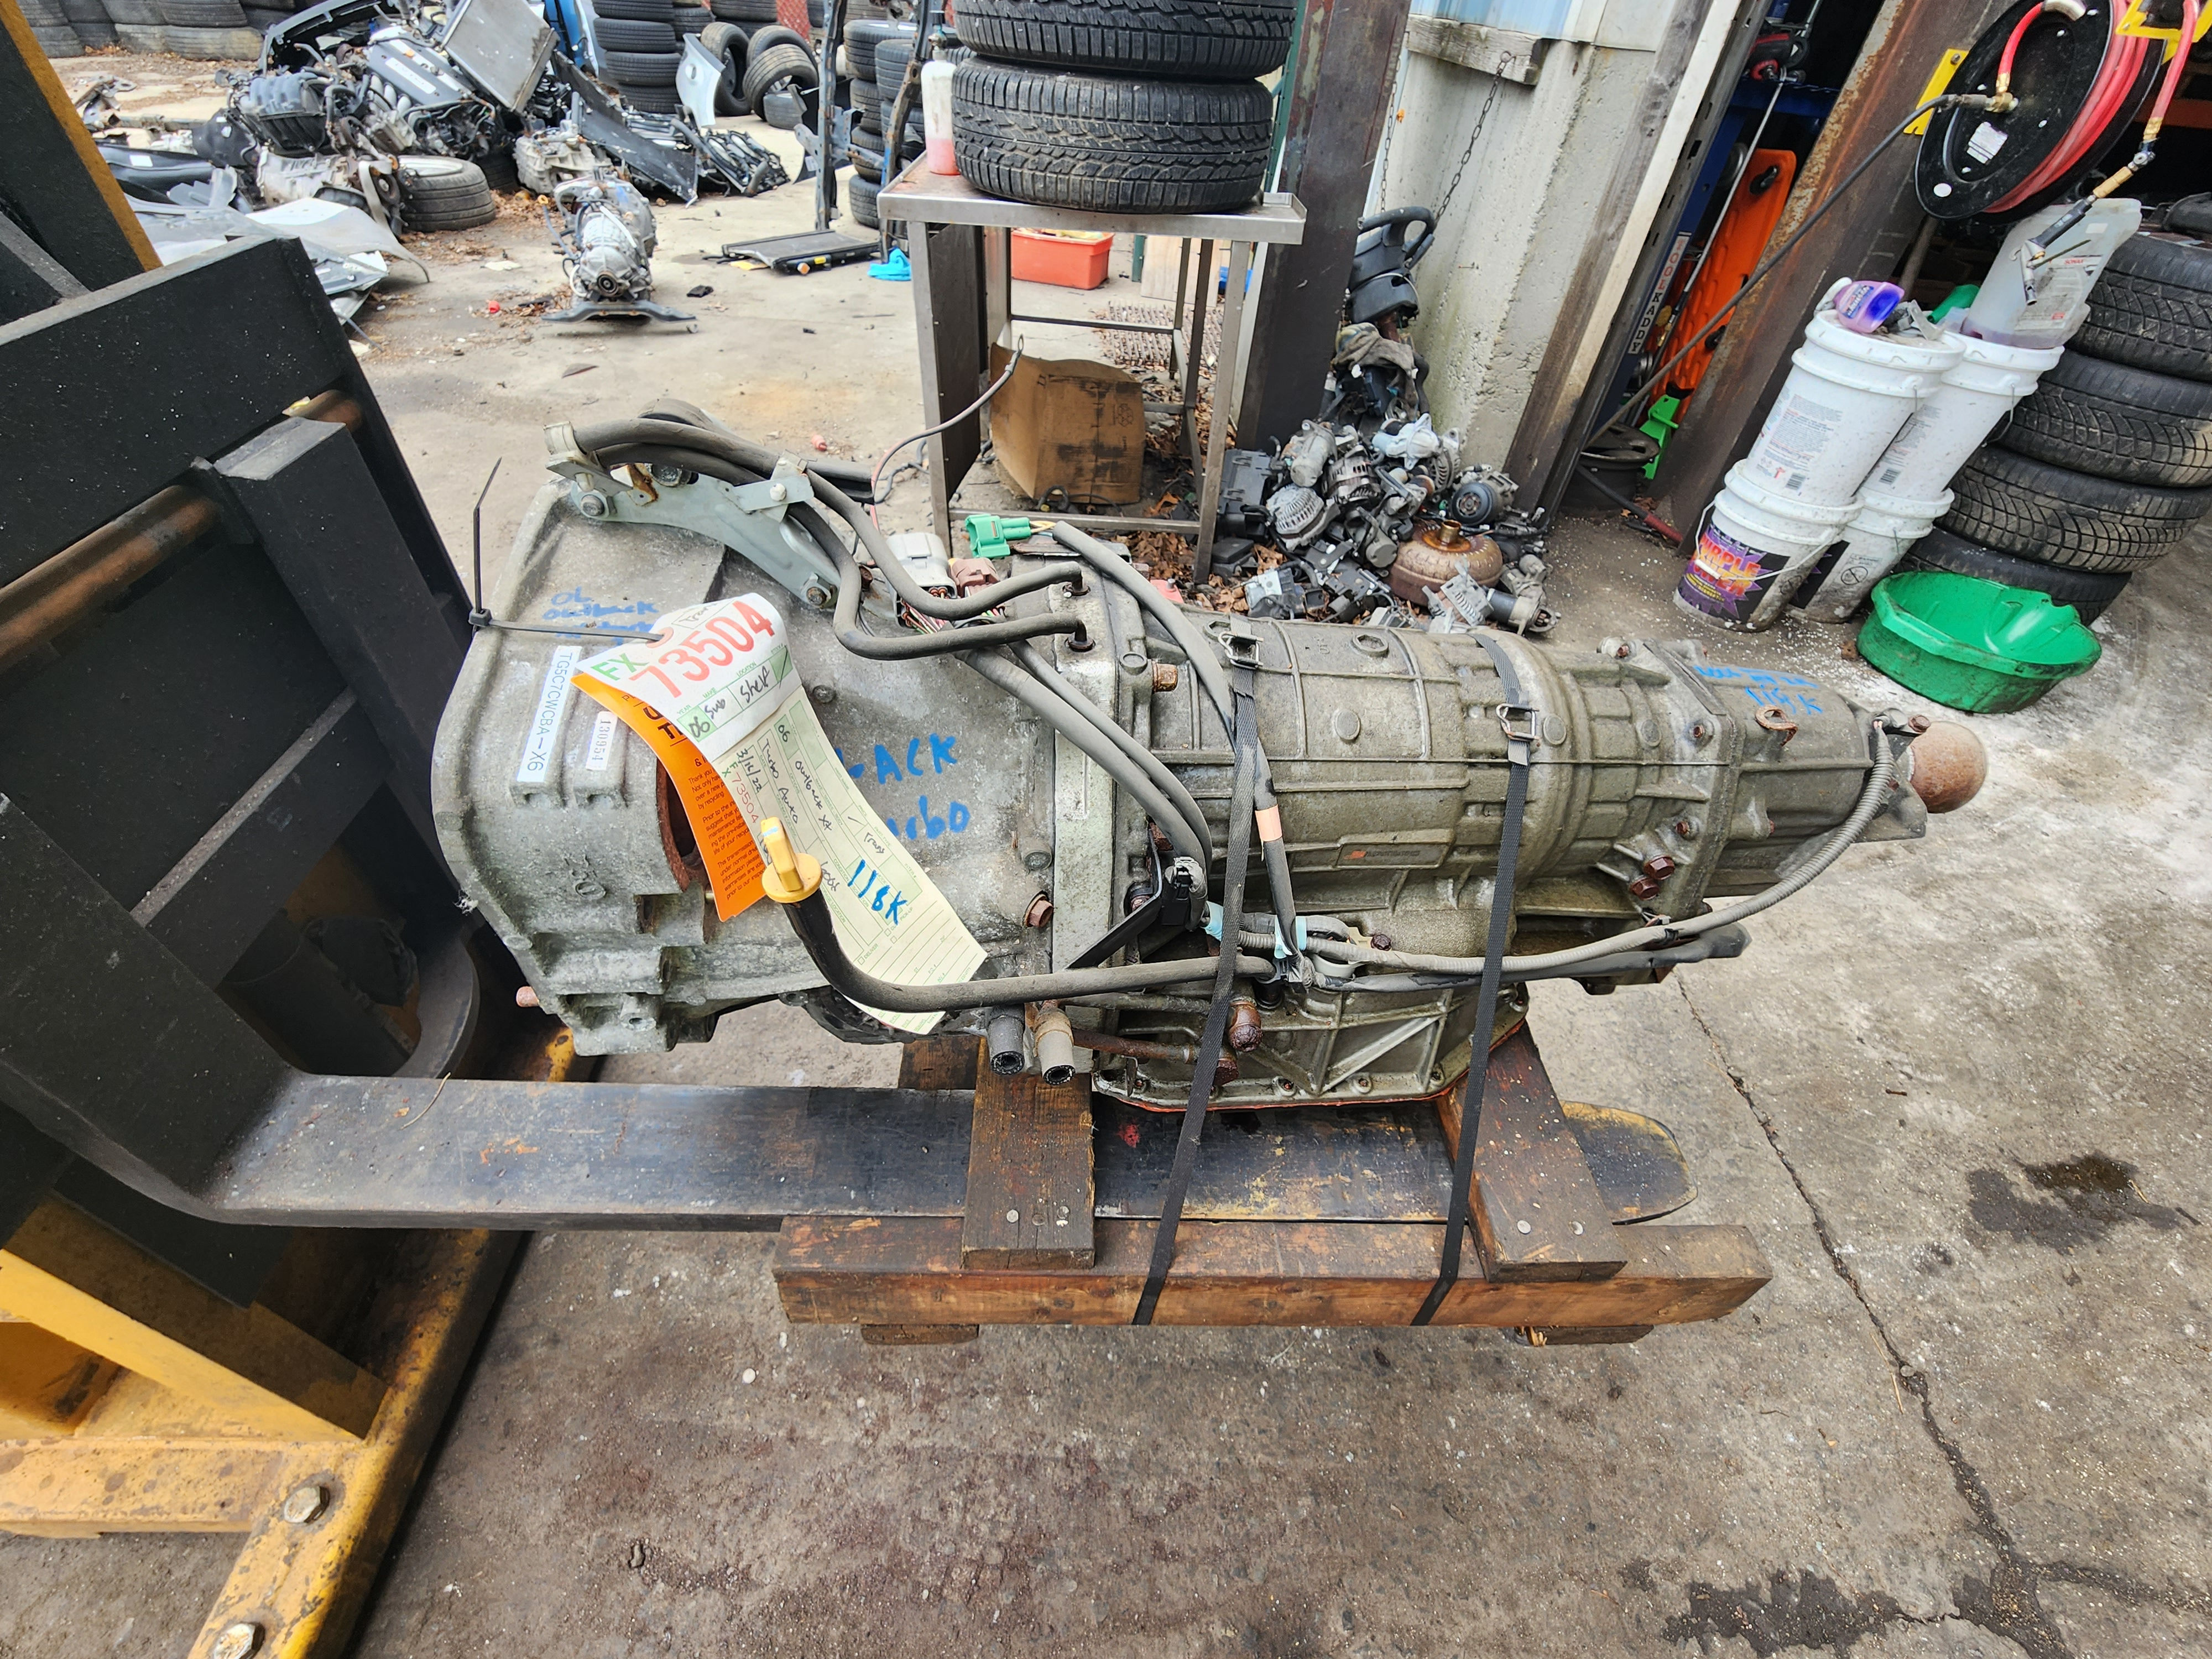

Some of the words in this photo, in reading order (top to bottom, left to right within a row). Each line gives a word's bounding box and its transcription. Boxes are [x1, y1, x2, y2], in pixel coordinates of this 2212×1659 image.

[629, 601, 775, 698] 73504
[737, 662, 757, 677] LOCATION
[677, 705, 691, 714] YEAR
[689, 717, 710, 738] 06
[778, 725, 790, 742] 06
[591, 719, 613, 763] 130954
[688, 771, 702, 785] Thank
[703, 766, 712, 779] you
[692, 782, 701, 794] Not
[702, 777, 711, 789] only
[695, 791, 706, 802] over
[710, 782, 720, 793] new
[698, 802, 704, 811] by
[704, 789, 724, 807] recycling
[732, 775, 759, 823] 73504
[702, 811, 715, 824] Prior
[705, 816, 724, 833] suggest
[723, 809, 733, 820] that
[717, 833, 726, 843] the
[726, 836, 736, 848] your
[717, 858, 726, 868] This
[831, 902, 845, 922] LOCATION
[863, 942, 879, 959] DELIVER
